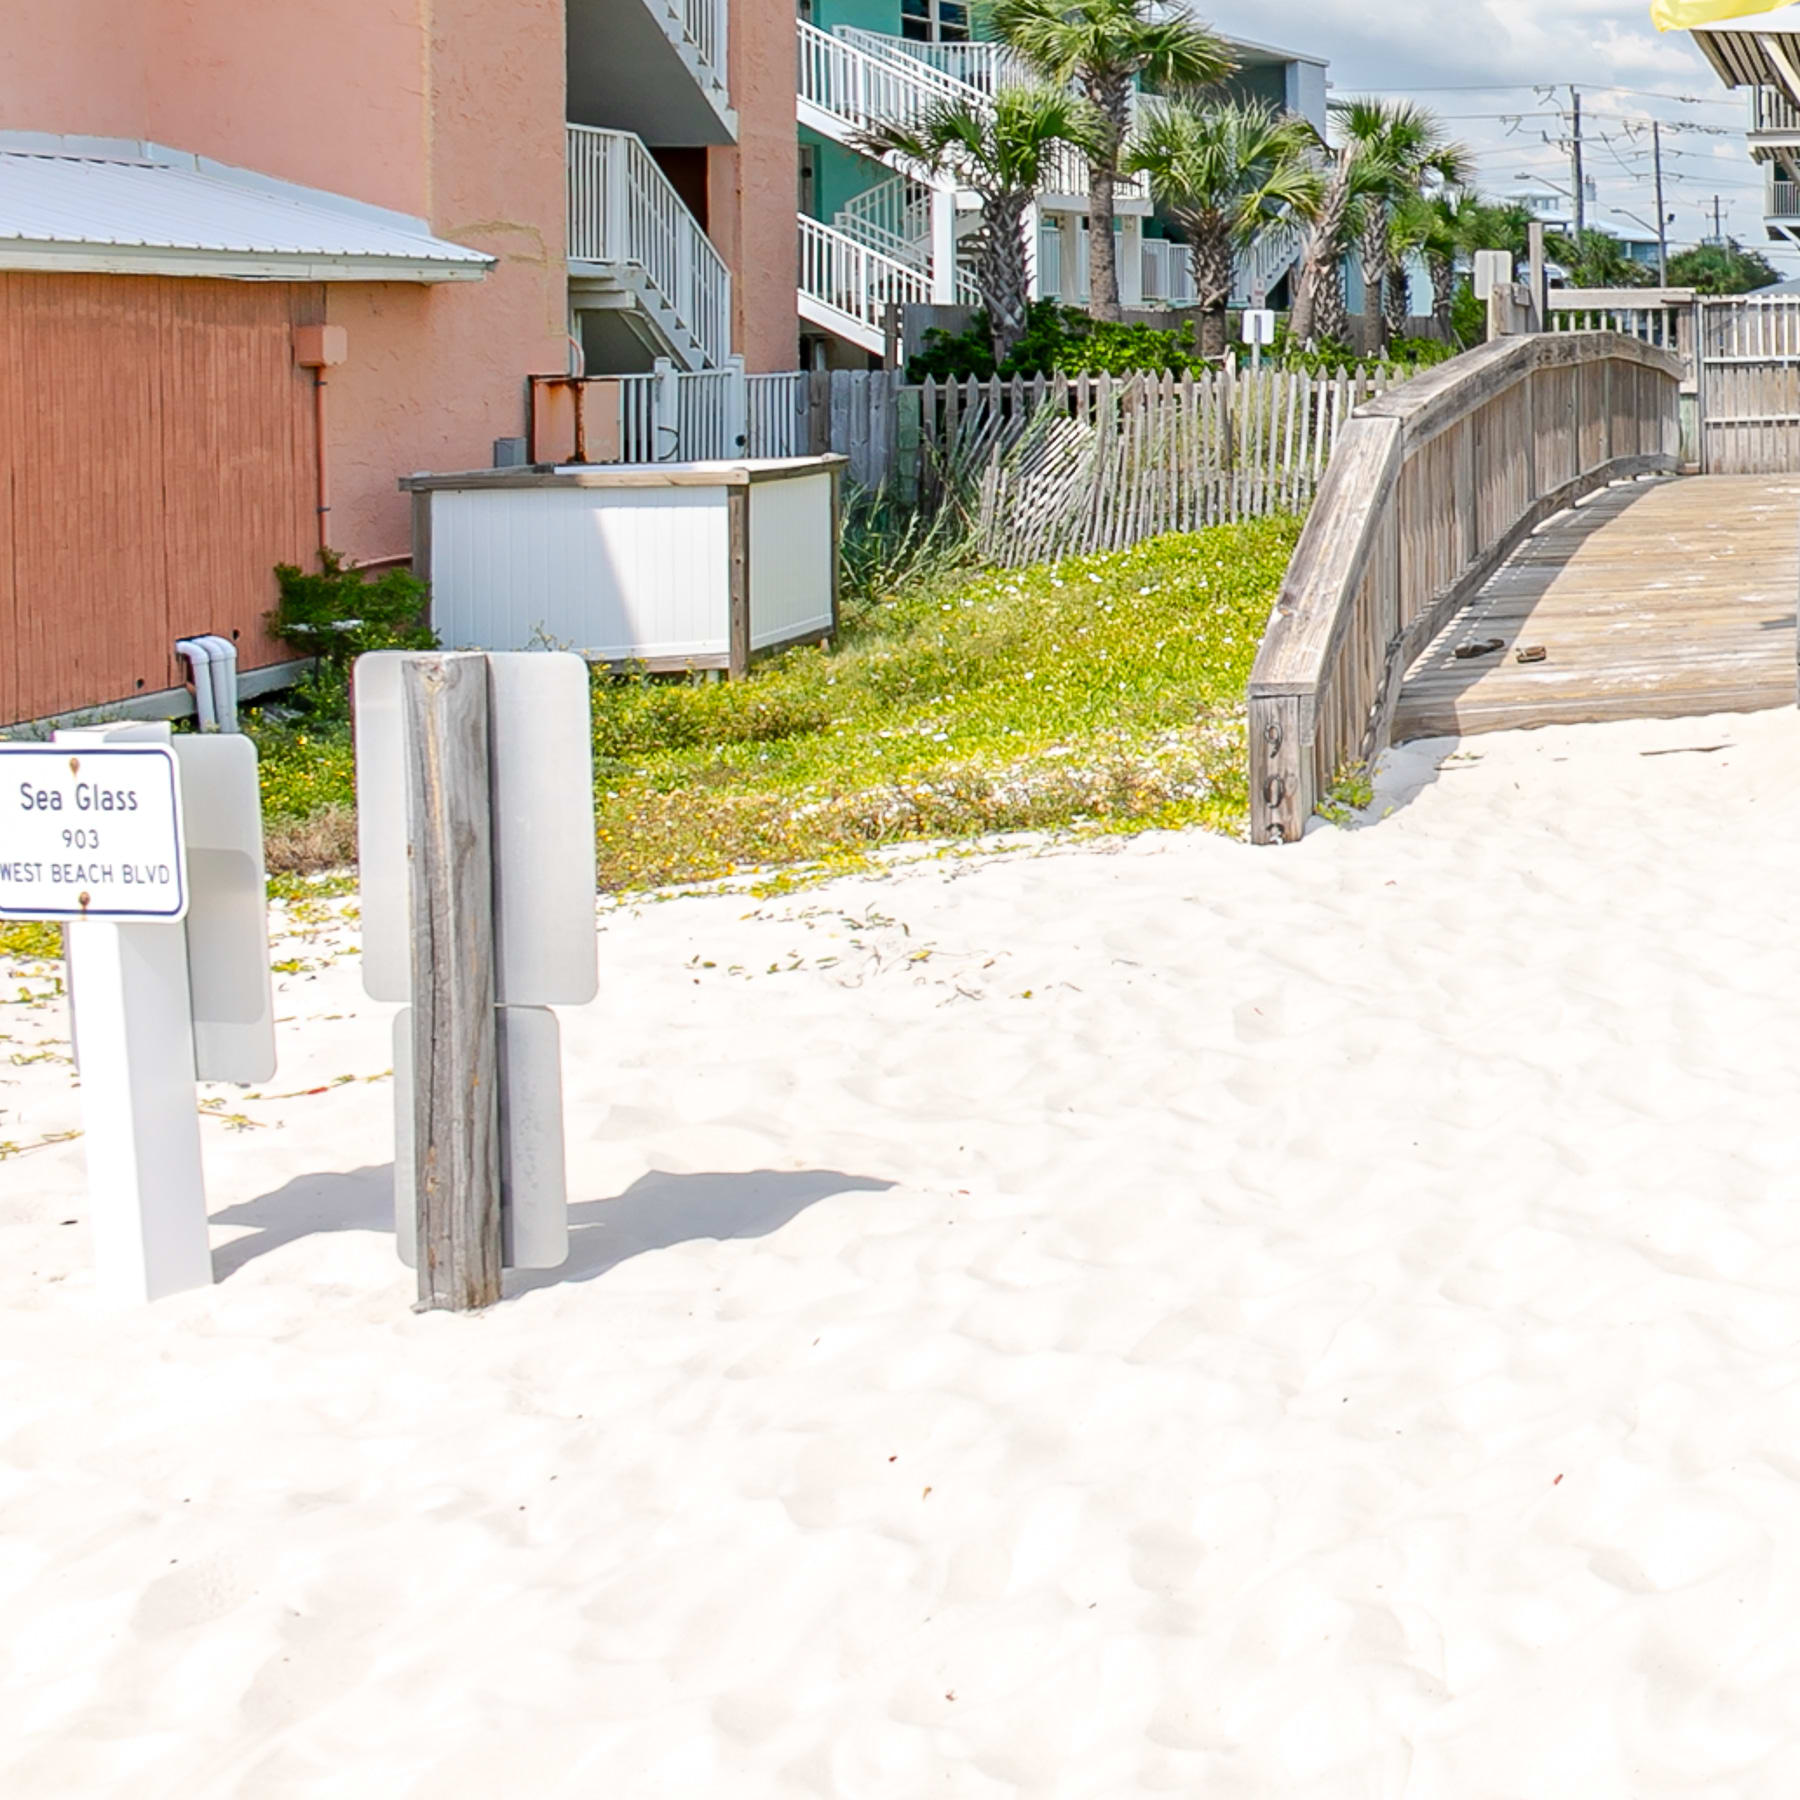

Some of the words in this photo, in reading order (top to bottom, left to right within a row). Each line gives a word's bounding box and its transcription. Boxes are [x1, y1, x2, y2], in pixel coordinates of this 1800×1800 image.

[20, 782, 63, 811] Sea
[75, 782, 138, 811] Glass
[61, 828, 99, 849] 903
[0, 862, 42, 882] WEST
[51, 863, 114, 884] BEACH
[121, 864, 170, 884] BLVD
